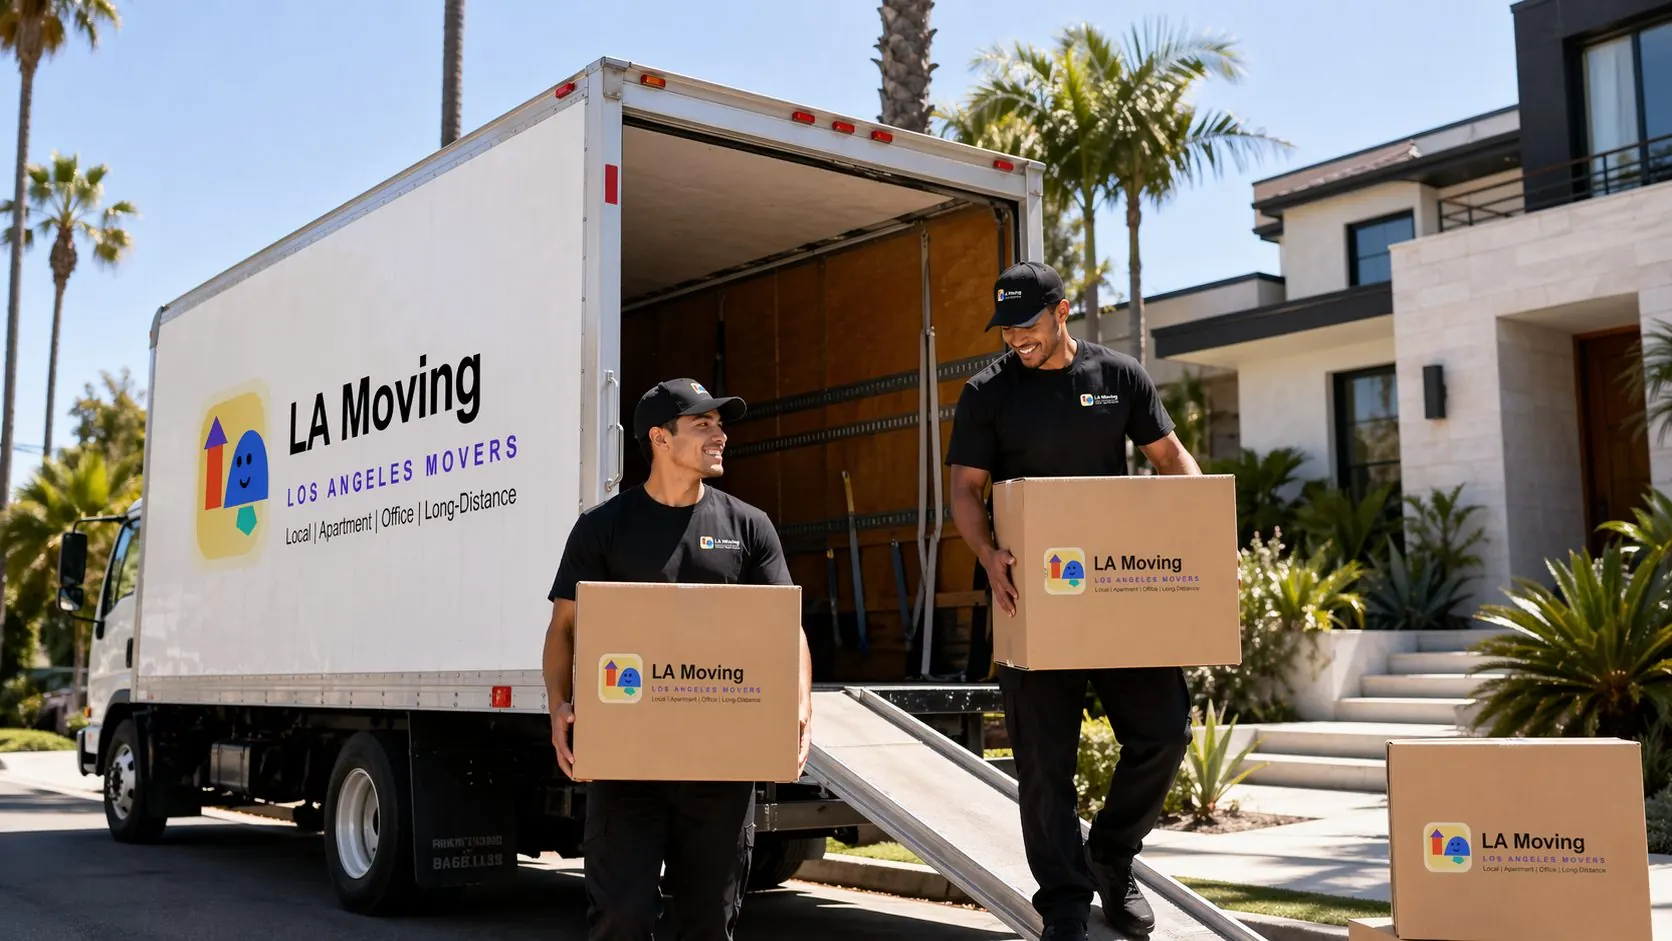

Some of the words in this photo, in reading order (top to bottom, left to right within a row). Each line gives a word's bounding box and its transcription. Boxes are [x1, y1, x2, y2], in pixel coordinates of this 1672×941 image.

[289, 392, 331, 456] LA
[341, 353, 481, 441] Moving
[287, 483, 318, 508] LOS
[327, 459, 414, 499] ANGELES
[425, 434, 518, 476] MOVERS
[285, 522, 312, 545] Local
[318, 513, 372, 542] Apartment
[381, 505, 414, 528] Office
[424, 487, 517, 521] Long-Distance
[1094, 555, 1116, 571] LA
[1121, 555, 1182, 573] Moving
[1094, 576, 1111, 584] LOS
[1116, 576, 1158, 584] ANGELES
[652, 663, 675, 680] LA
[680, 664, 744, 684] Moving
[1482, 832, 1508, 849] LA
[1514, 833, 1585, 854] Moving
[1562, 856, 1605, 864] MOVERS
